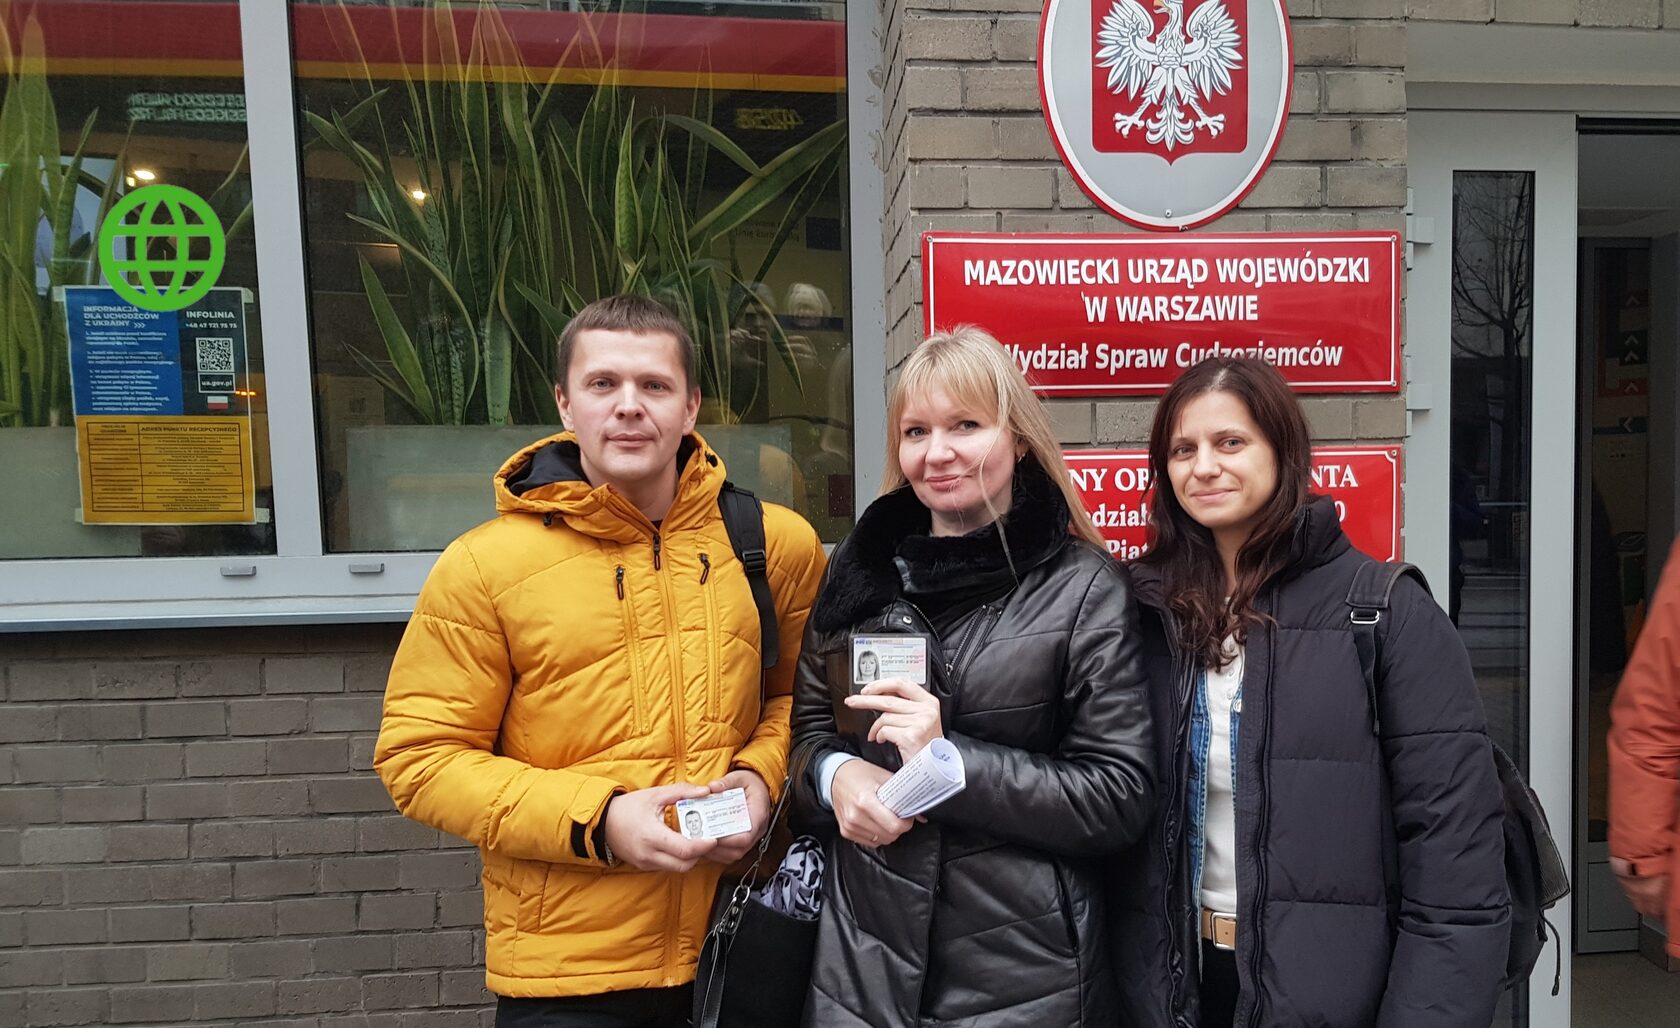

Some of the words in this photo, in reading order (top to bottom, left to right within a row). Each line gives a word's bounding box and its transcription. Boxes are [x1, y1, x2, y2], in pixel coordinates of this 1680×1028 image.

[963, 257, 1120, 286] MAZOWIECKI
[1127, 256, 1208, 290] URZĄD
[1215, 251, 1370, 289] WOJEWÓDZKI
[83, 305, 139, 313] INFORMACJA
[185, 310, 235, 319] INFOLINIA
[1083, 295, 1108, 323] W
[1116, 294, 1258, 323] WARSZAWIE
[92, 319, 130, 327] UKRAINY
[1095, 343, 1168, 376] Spraw
[201, 379, 233, 387] ua.gov.pl
[1067, 467, 1108, 492] NY
[1307, 464, 1359, 488] NTA
